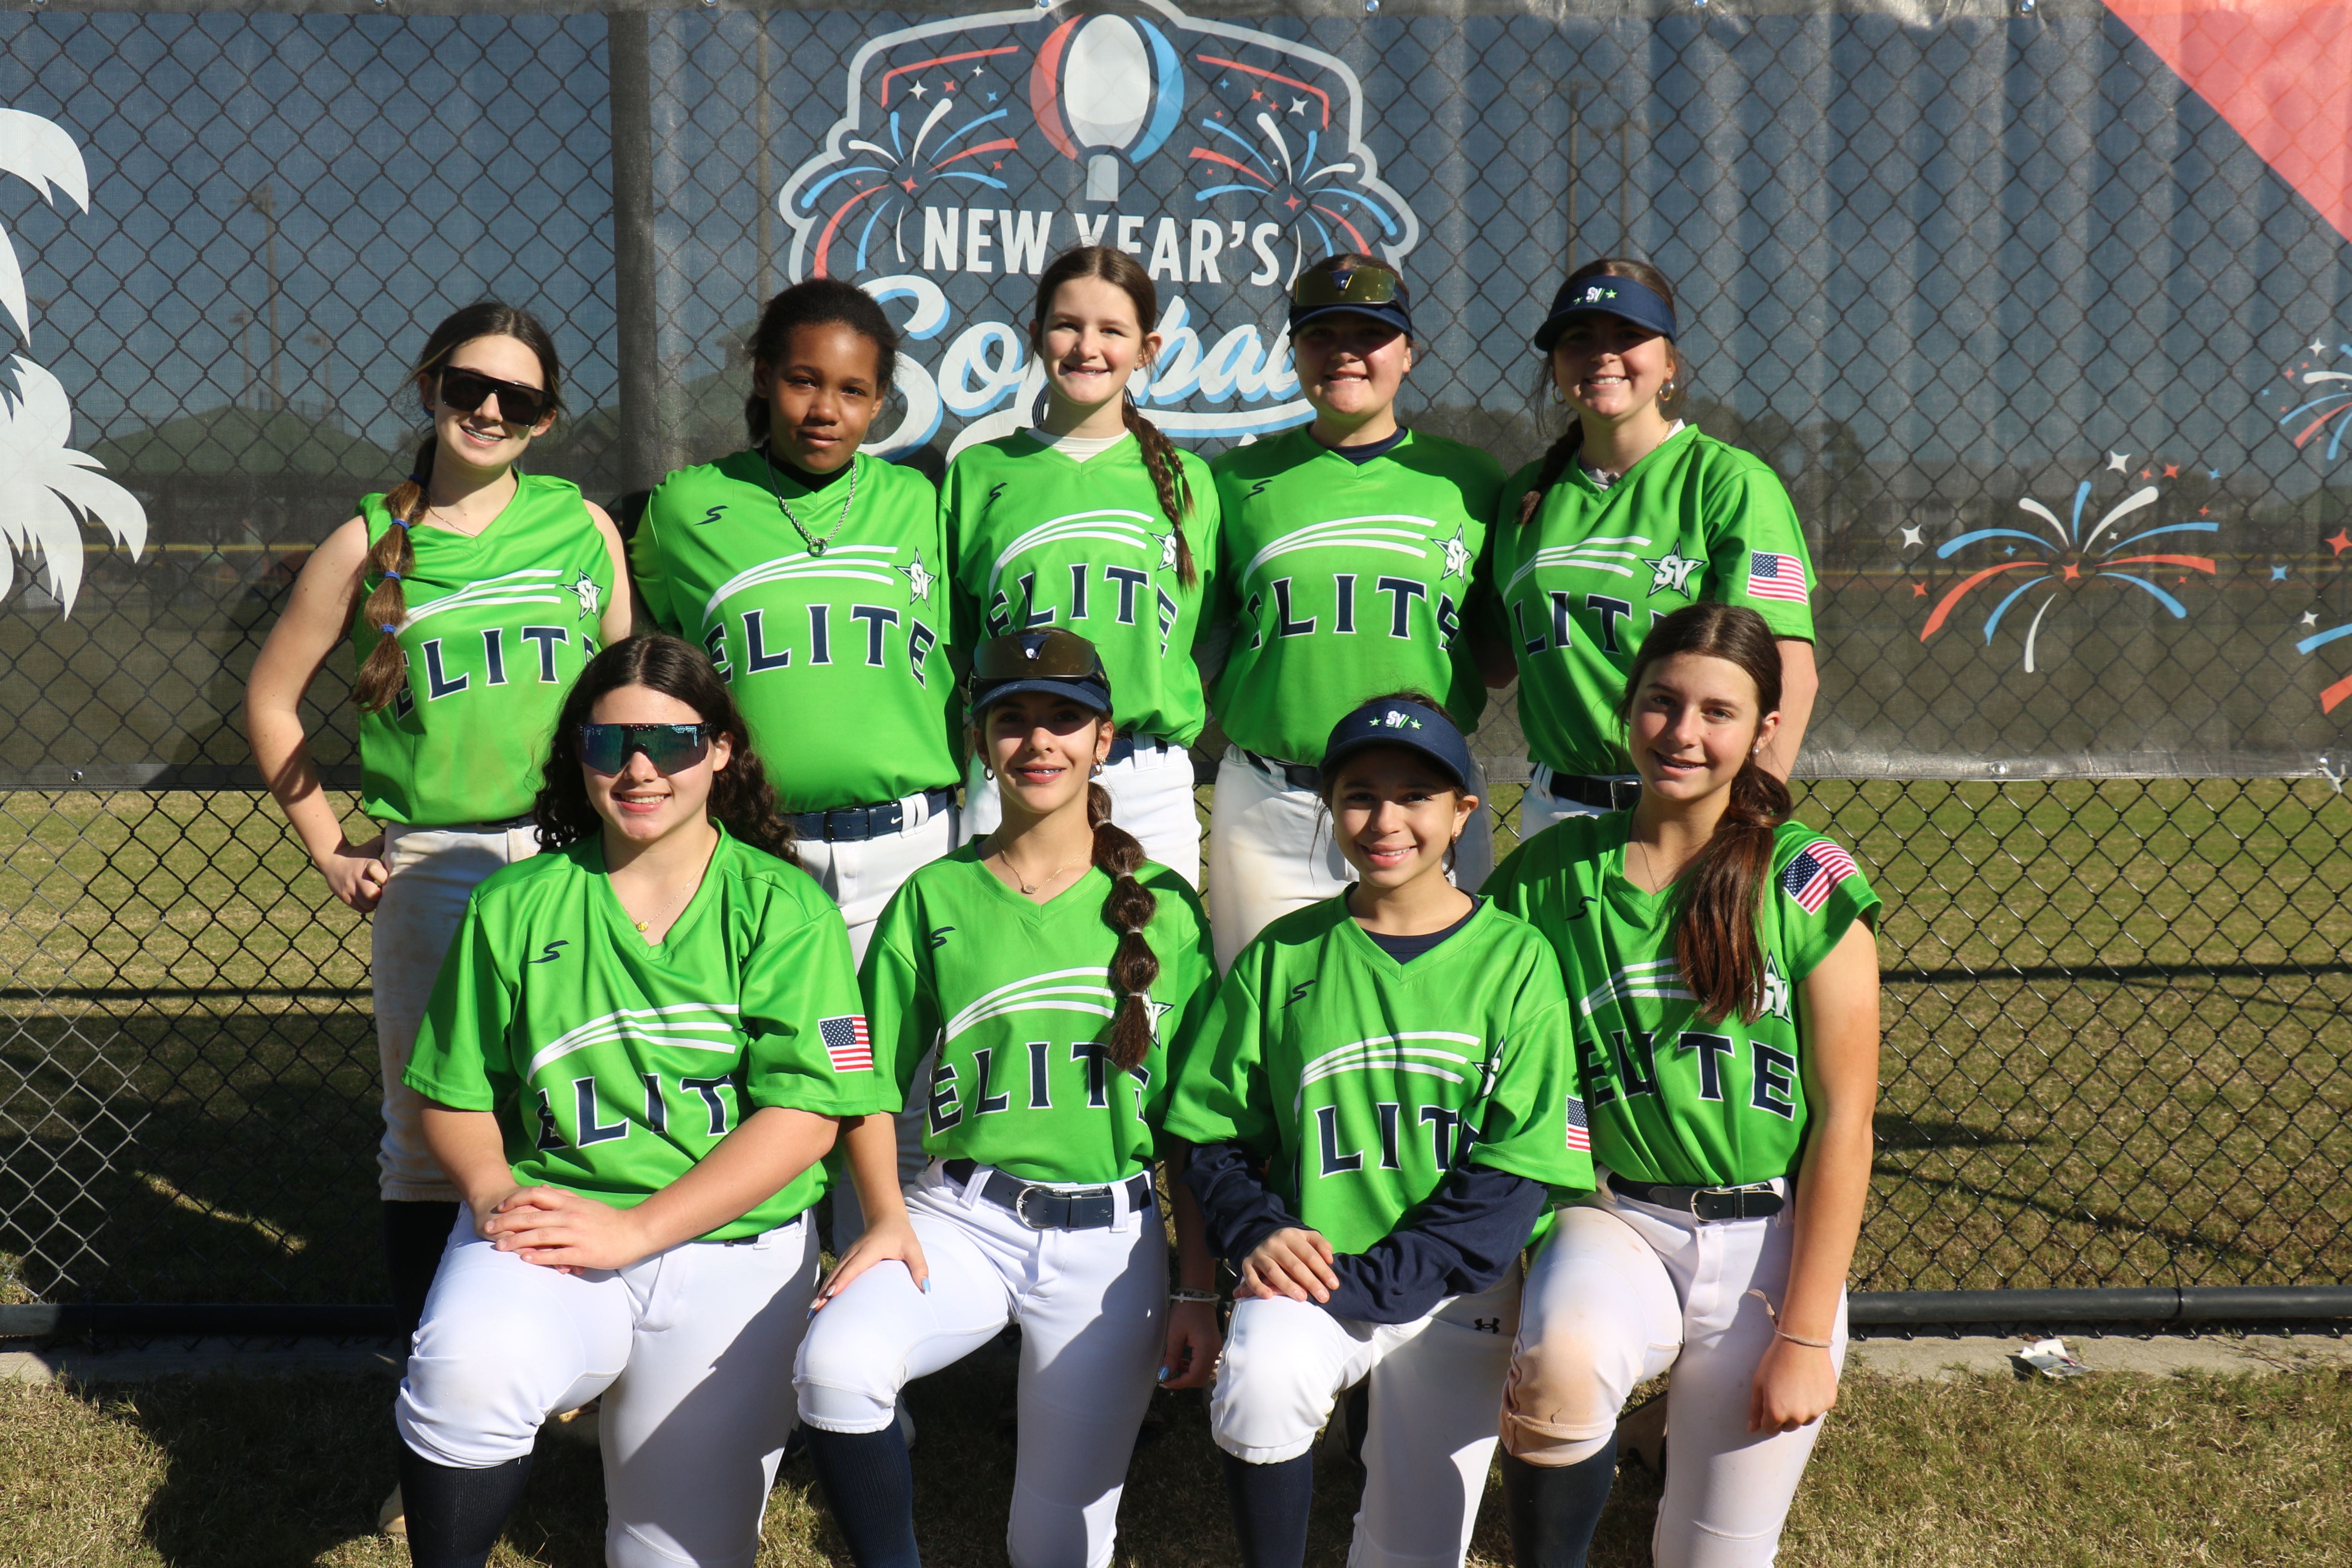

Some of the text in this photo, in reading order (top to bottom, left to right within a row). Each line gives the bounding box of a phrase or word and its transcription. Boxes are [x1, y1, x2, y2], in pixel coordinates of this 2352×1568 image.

[923, 206, 1053, 275] NEW
[702, 603, 937, 690] ELITE
[1512, 590, 1667, 661] LIT
[394, 625, 596, 722] ELIT
[536, 1072, 737, 1152] ELIT
[1293, 1102, 1480, 1195] LIT
